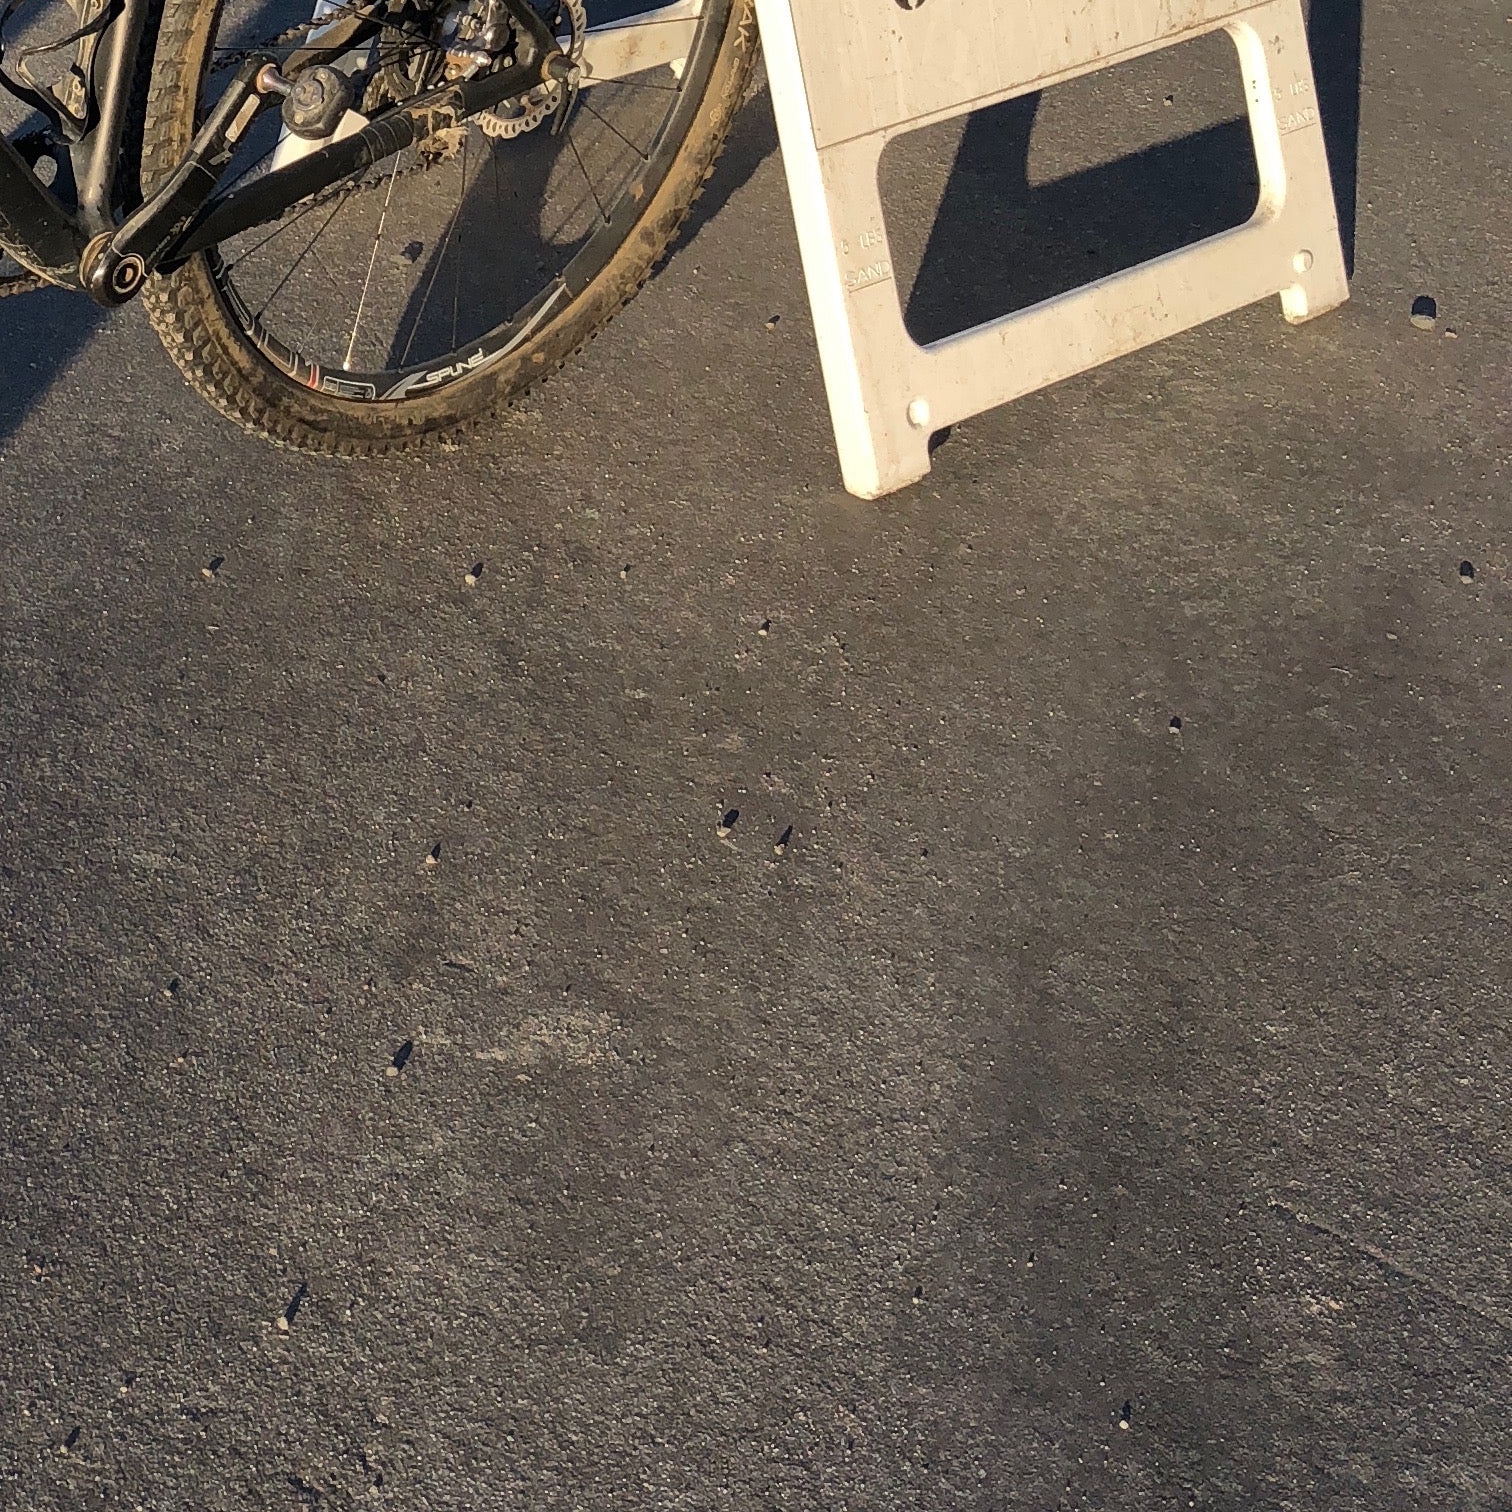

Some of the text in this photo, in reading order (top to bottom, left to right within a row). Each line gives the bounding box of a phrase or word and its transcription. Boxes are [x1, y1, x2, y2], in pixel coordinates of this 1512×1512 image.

[1277, 106, 1316, 131] SAND
[859, 227, 883, 249] LBS
[844, 259, 890, 287] SAND
